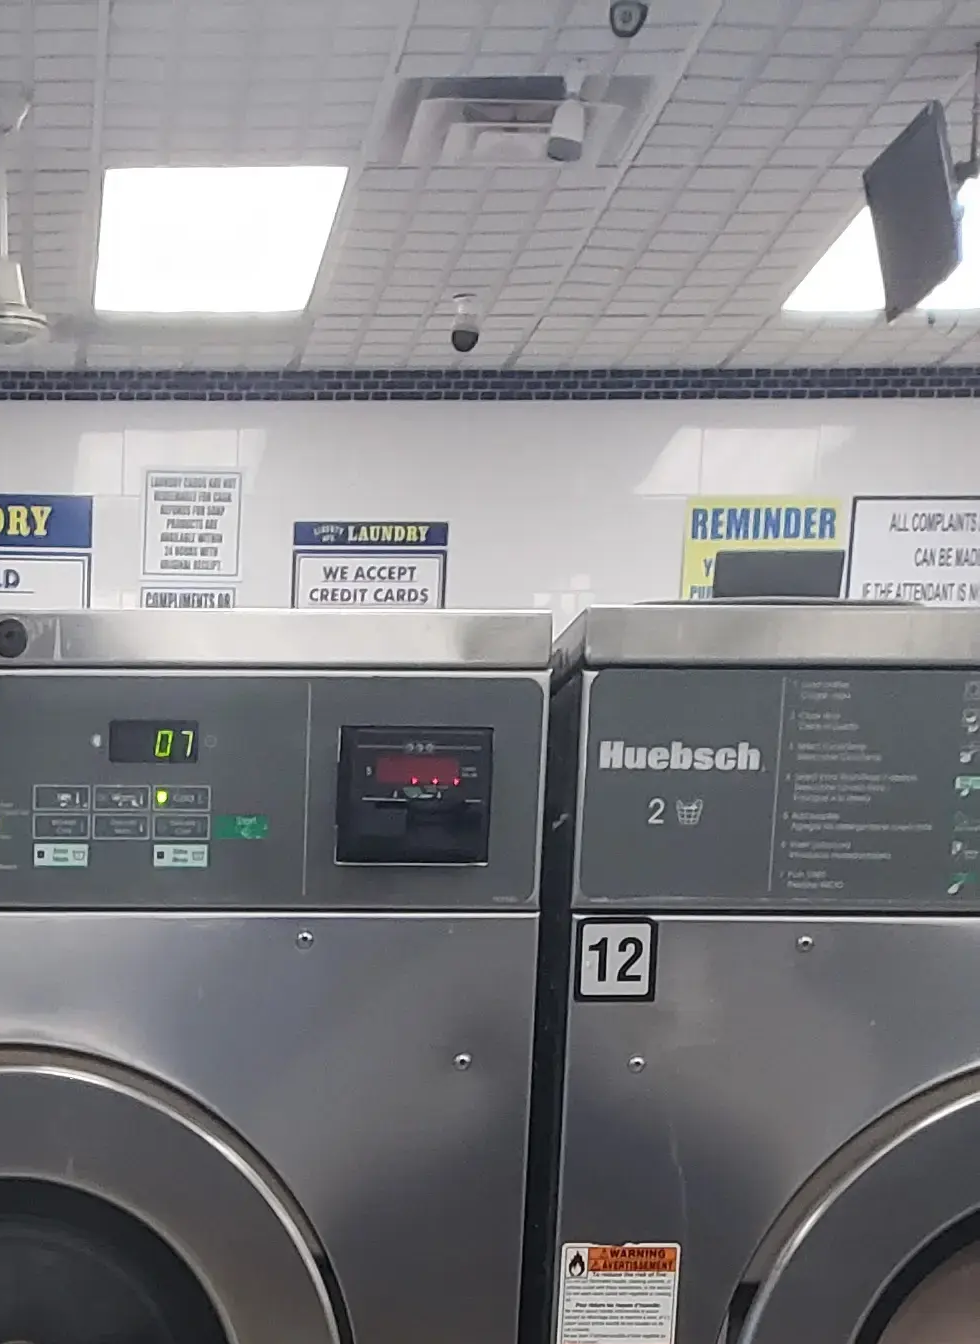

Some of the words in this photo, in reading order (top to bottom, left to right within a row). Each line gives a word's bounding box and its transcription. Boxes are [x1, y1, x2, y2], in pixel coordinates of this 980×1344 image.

[691, 507, 836, 540] REMINDER
[889, 512, 909, 532] ALL
[912, 512, 977, 532] COMPLAINTS
[348, 526, 430, 542] LAUNDRY
[915, 548, 935, 567] CAN
[939, 547, 953, 566] BE
[323, 566, 349, 580] WE
[354, 566, 417, 580] ACCEPT
[309, 588, 368, 602] CREDIT
[374, 588, 429, 604] CARDS
[874, 583, 893, 600] THE
[896, 583, 955, 601] ATTENDANT
[154, 729, 194, 758] 07
[600, 740, 760, 771] Huebsch
[648, 798, 664, 824] 2
[588, 937, 644, 982] 12
[610, 1249, 666, 1258] WARNING
[602, 1260, 673, 1270] AVERTISSEMENT
